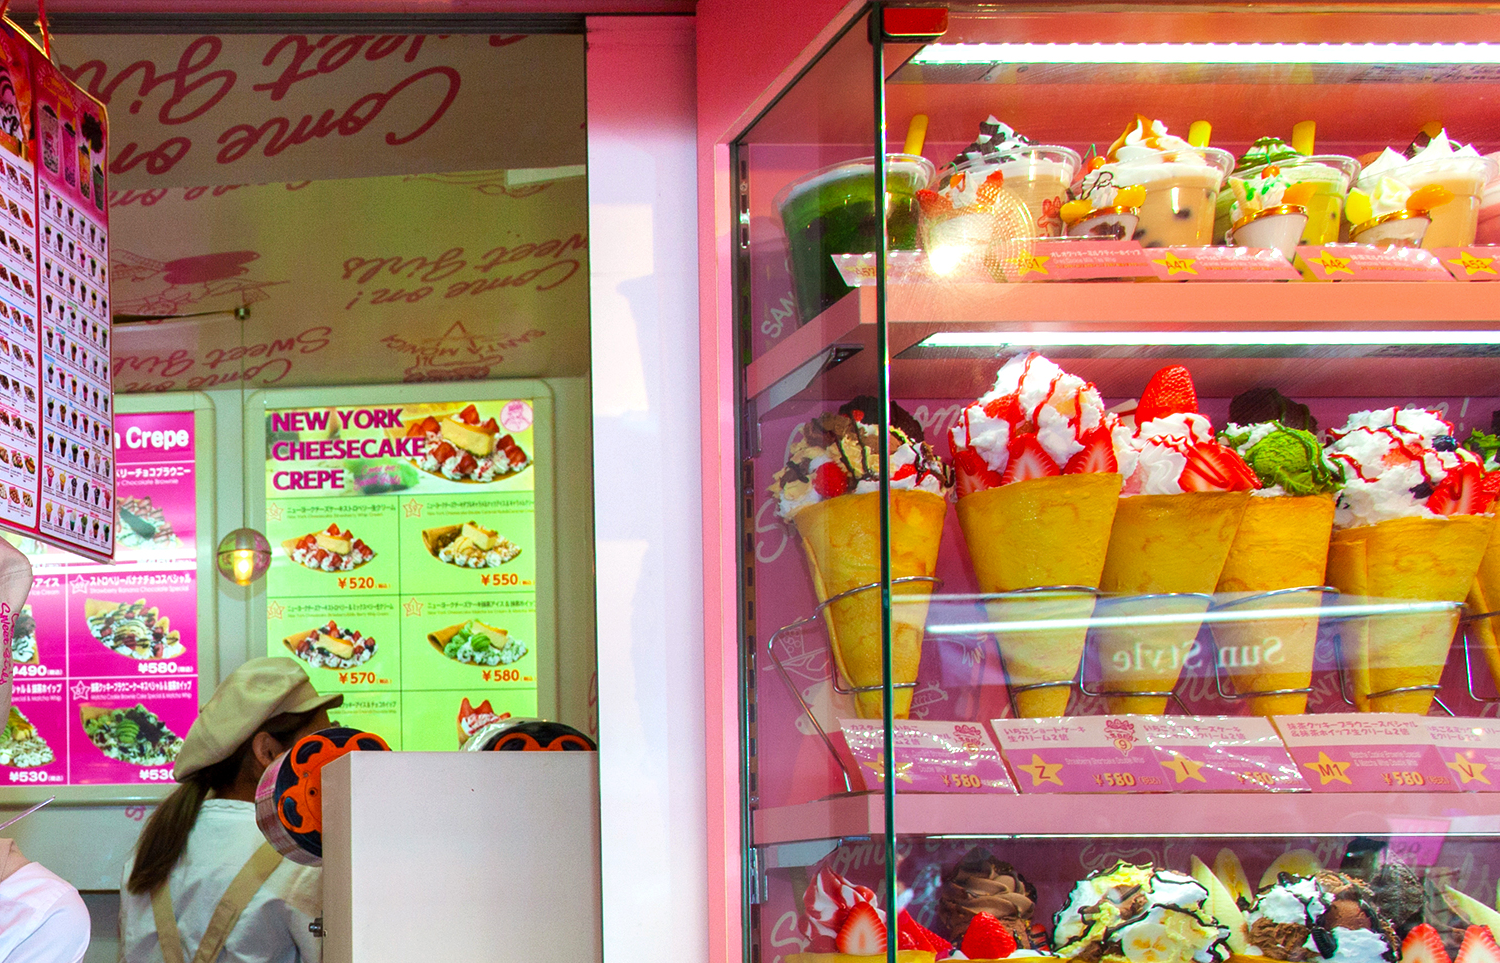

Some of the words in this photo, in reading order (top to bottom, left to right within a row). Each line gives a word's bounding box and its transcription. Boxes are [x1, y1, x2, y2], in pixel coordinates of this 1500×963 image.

[217, 67, 461, 165] Come
[342, 247, 466, 284] Girls
[1165, 260, 1188, 271] A47
[1321, 259, 1344, 270] A48
[1464, 259, 1487, 270] A53
[452, 259, 580, 293] Come
[203, 326, 331, 366] Sweet
[272, 411, 329, 432] NEW
[337, 408, 403, 430] YORK
[126, 427, 189, 449] Crepe
[272, 437, 425, 461] CHEESECAKE
[272, 469, 344, 491] CREPE
[338, 577, 374, 589] ¥520
[481, 573, 518, 586] ¥550
[138, 662, 177, 674] ¥580
[339, 672, 376, 685] ¥570
[482, 669, 520, 682] ¥580
[1004, 726, 1086, 736] いちごショートケーキ
[1287, 721, 1418, 730] 抹茶クッキーブラウニースペシャル
[1291, 728, 1411, 737] &抹茶ホイップ生クリーム2倍
[1119, 739, 1128, 750] 9
[9, 771, 47, 782] ¥530
[1035, 765, 1051, 779] Z
[1318, 763, 1343, 777] M1
[1458, 764, 1474, 778] V
[941, 774, 982, 788] ¥580
[1092, 772, 1136, 786] ¥580
[1381, 771, 1425, 786] ¥580
